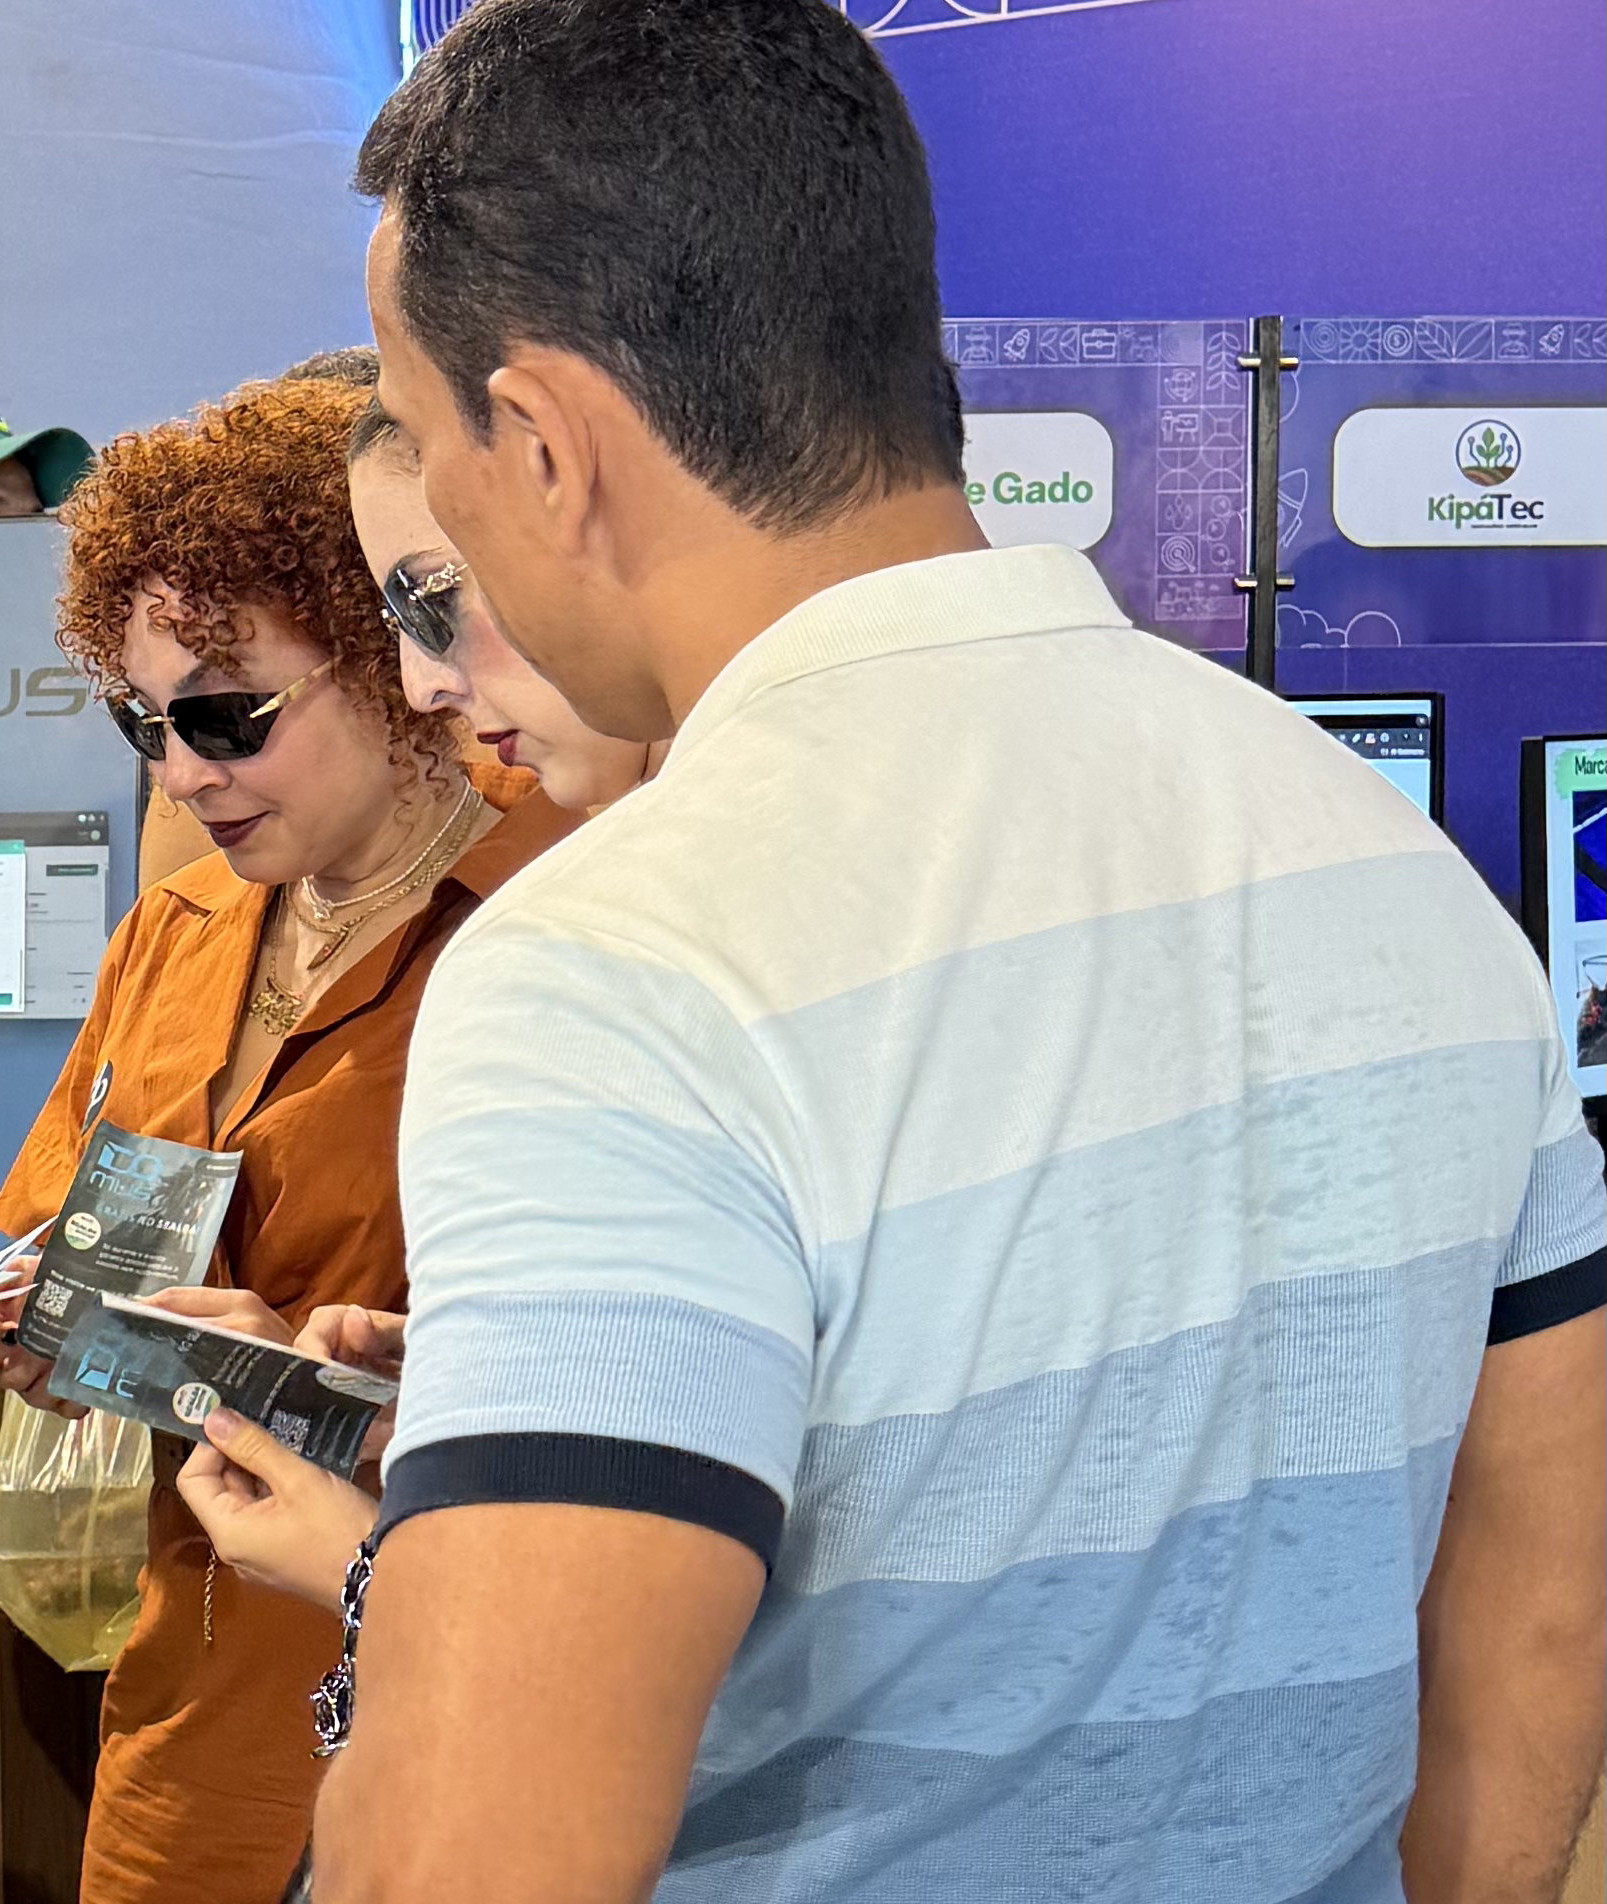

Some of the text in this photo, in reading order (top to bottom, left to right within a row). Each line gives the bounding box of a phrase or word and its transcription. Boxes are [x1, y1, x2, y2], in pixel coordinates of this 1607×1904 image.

[992, 471, 1094, 505] Gado
[1427, 493, 1545, 530] KipáTec
[1575, 755, 1607, 776] Marc
